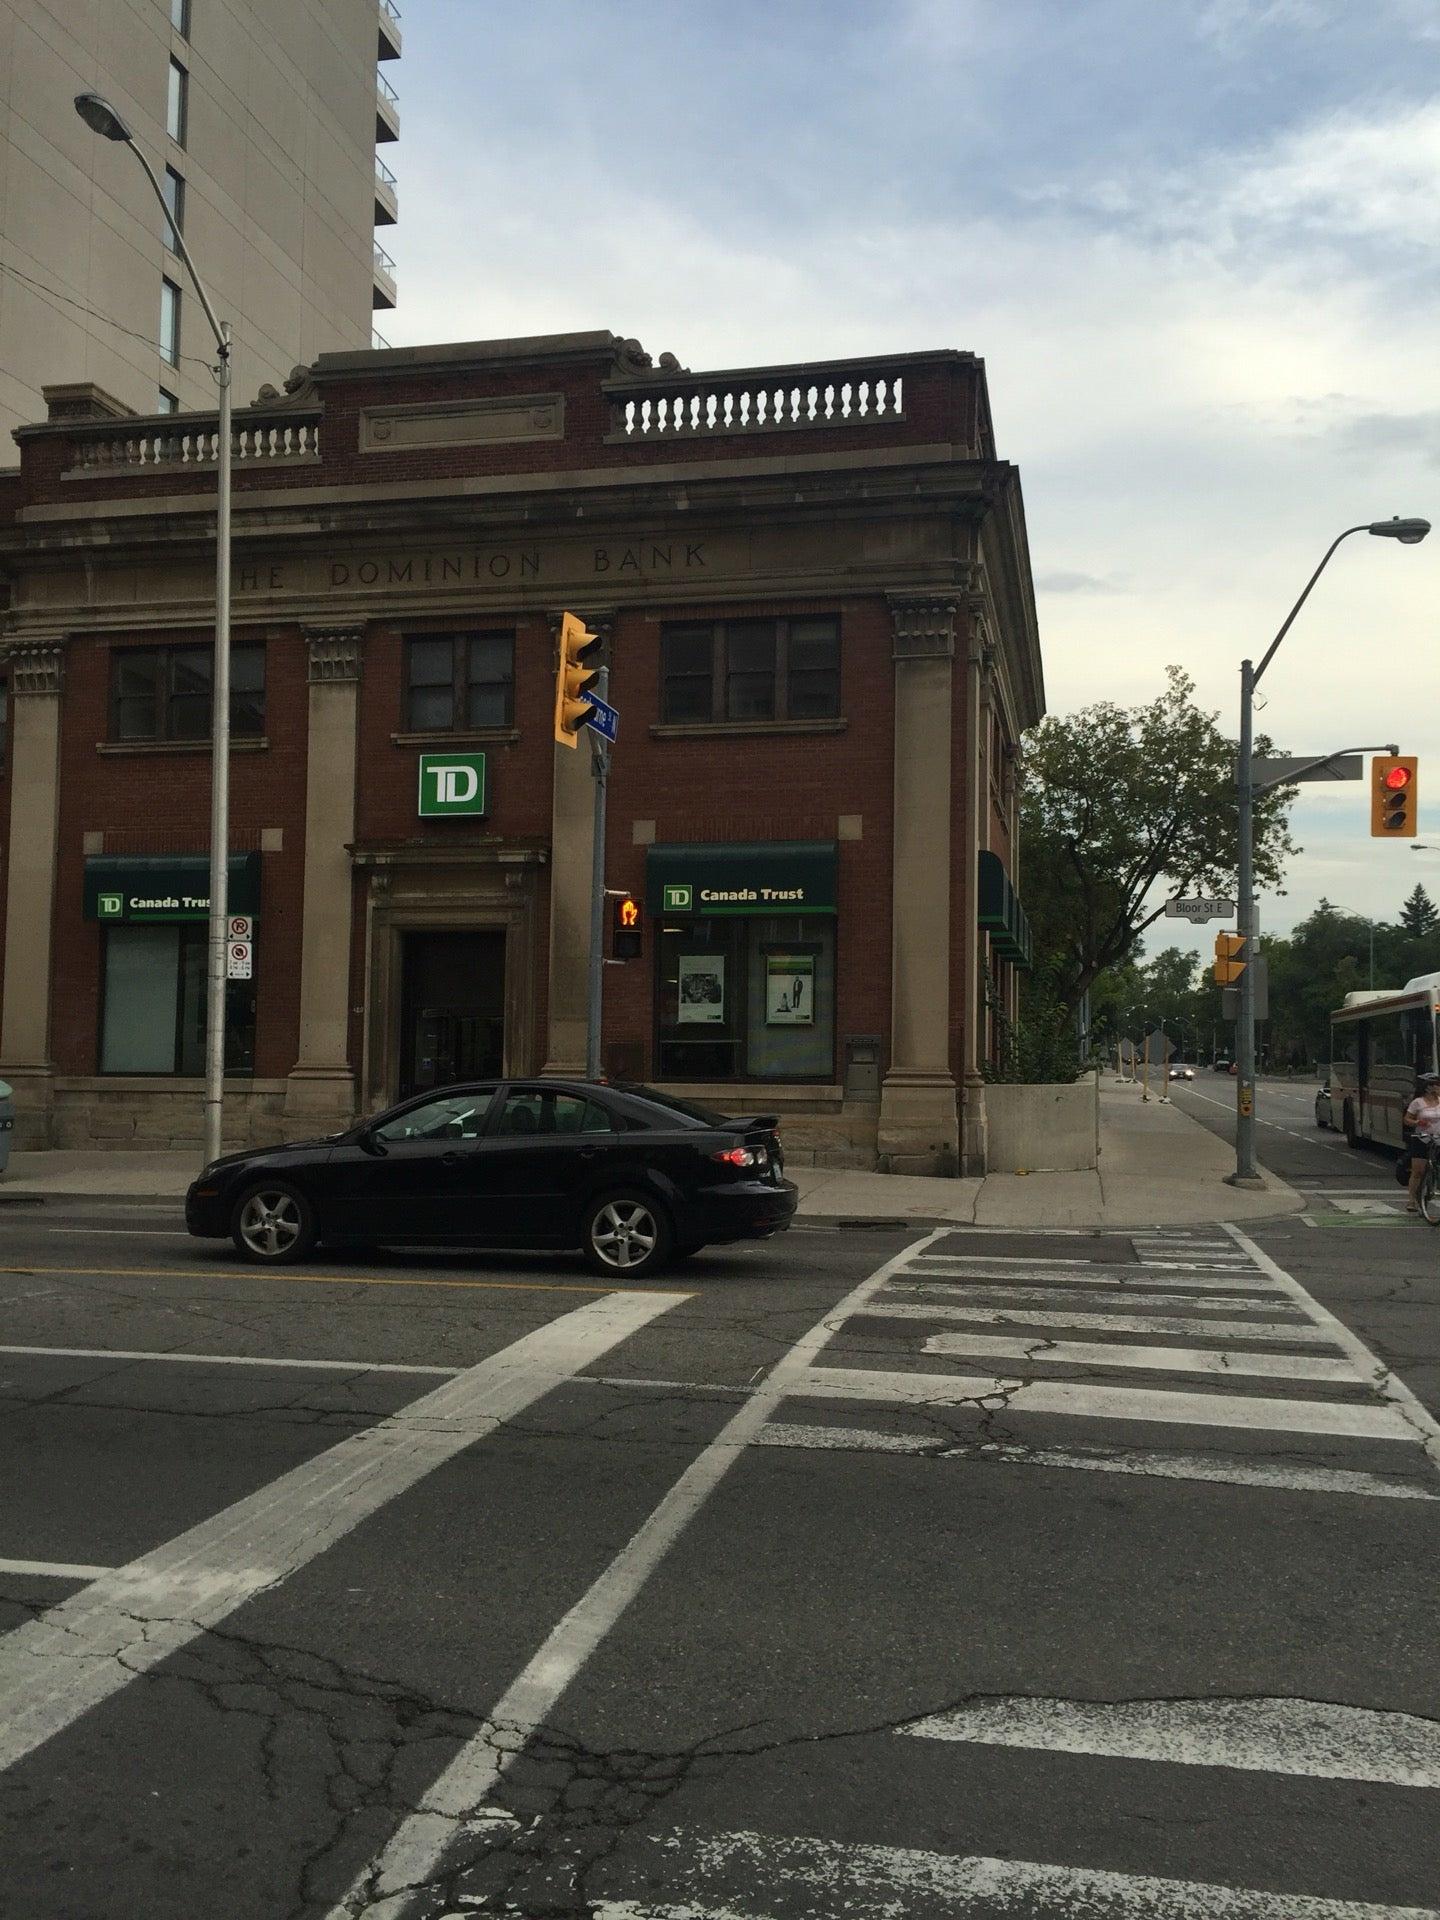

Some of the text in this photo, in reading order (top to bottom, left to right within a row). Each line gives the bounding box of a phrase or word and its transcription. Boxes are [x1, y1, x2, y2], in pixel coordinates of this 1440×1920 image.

[240, 543, 705, 590] HE DOMINION BANK
[426, 766, 478, 803] TD
[101, 896, 211, 913] TD Canada Trus
[667, 887, 804, 906] TD Canada Trust
[1175, 902, 1223, 913] Bloor St E
